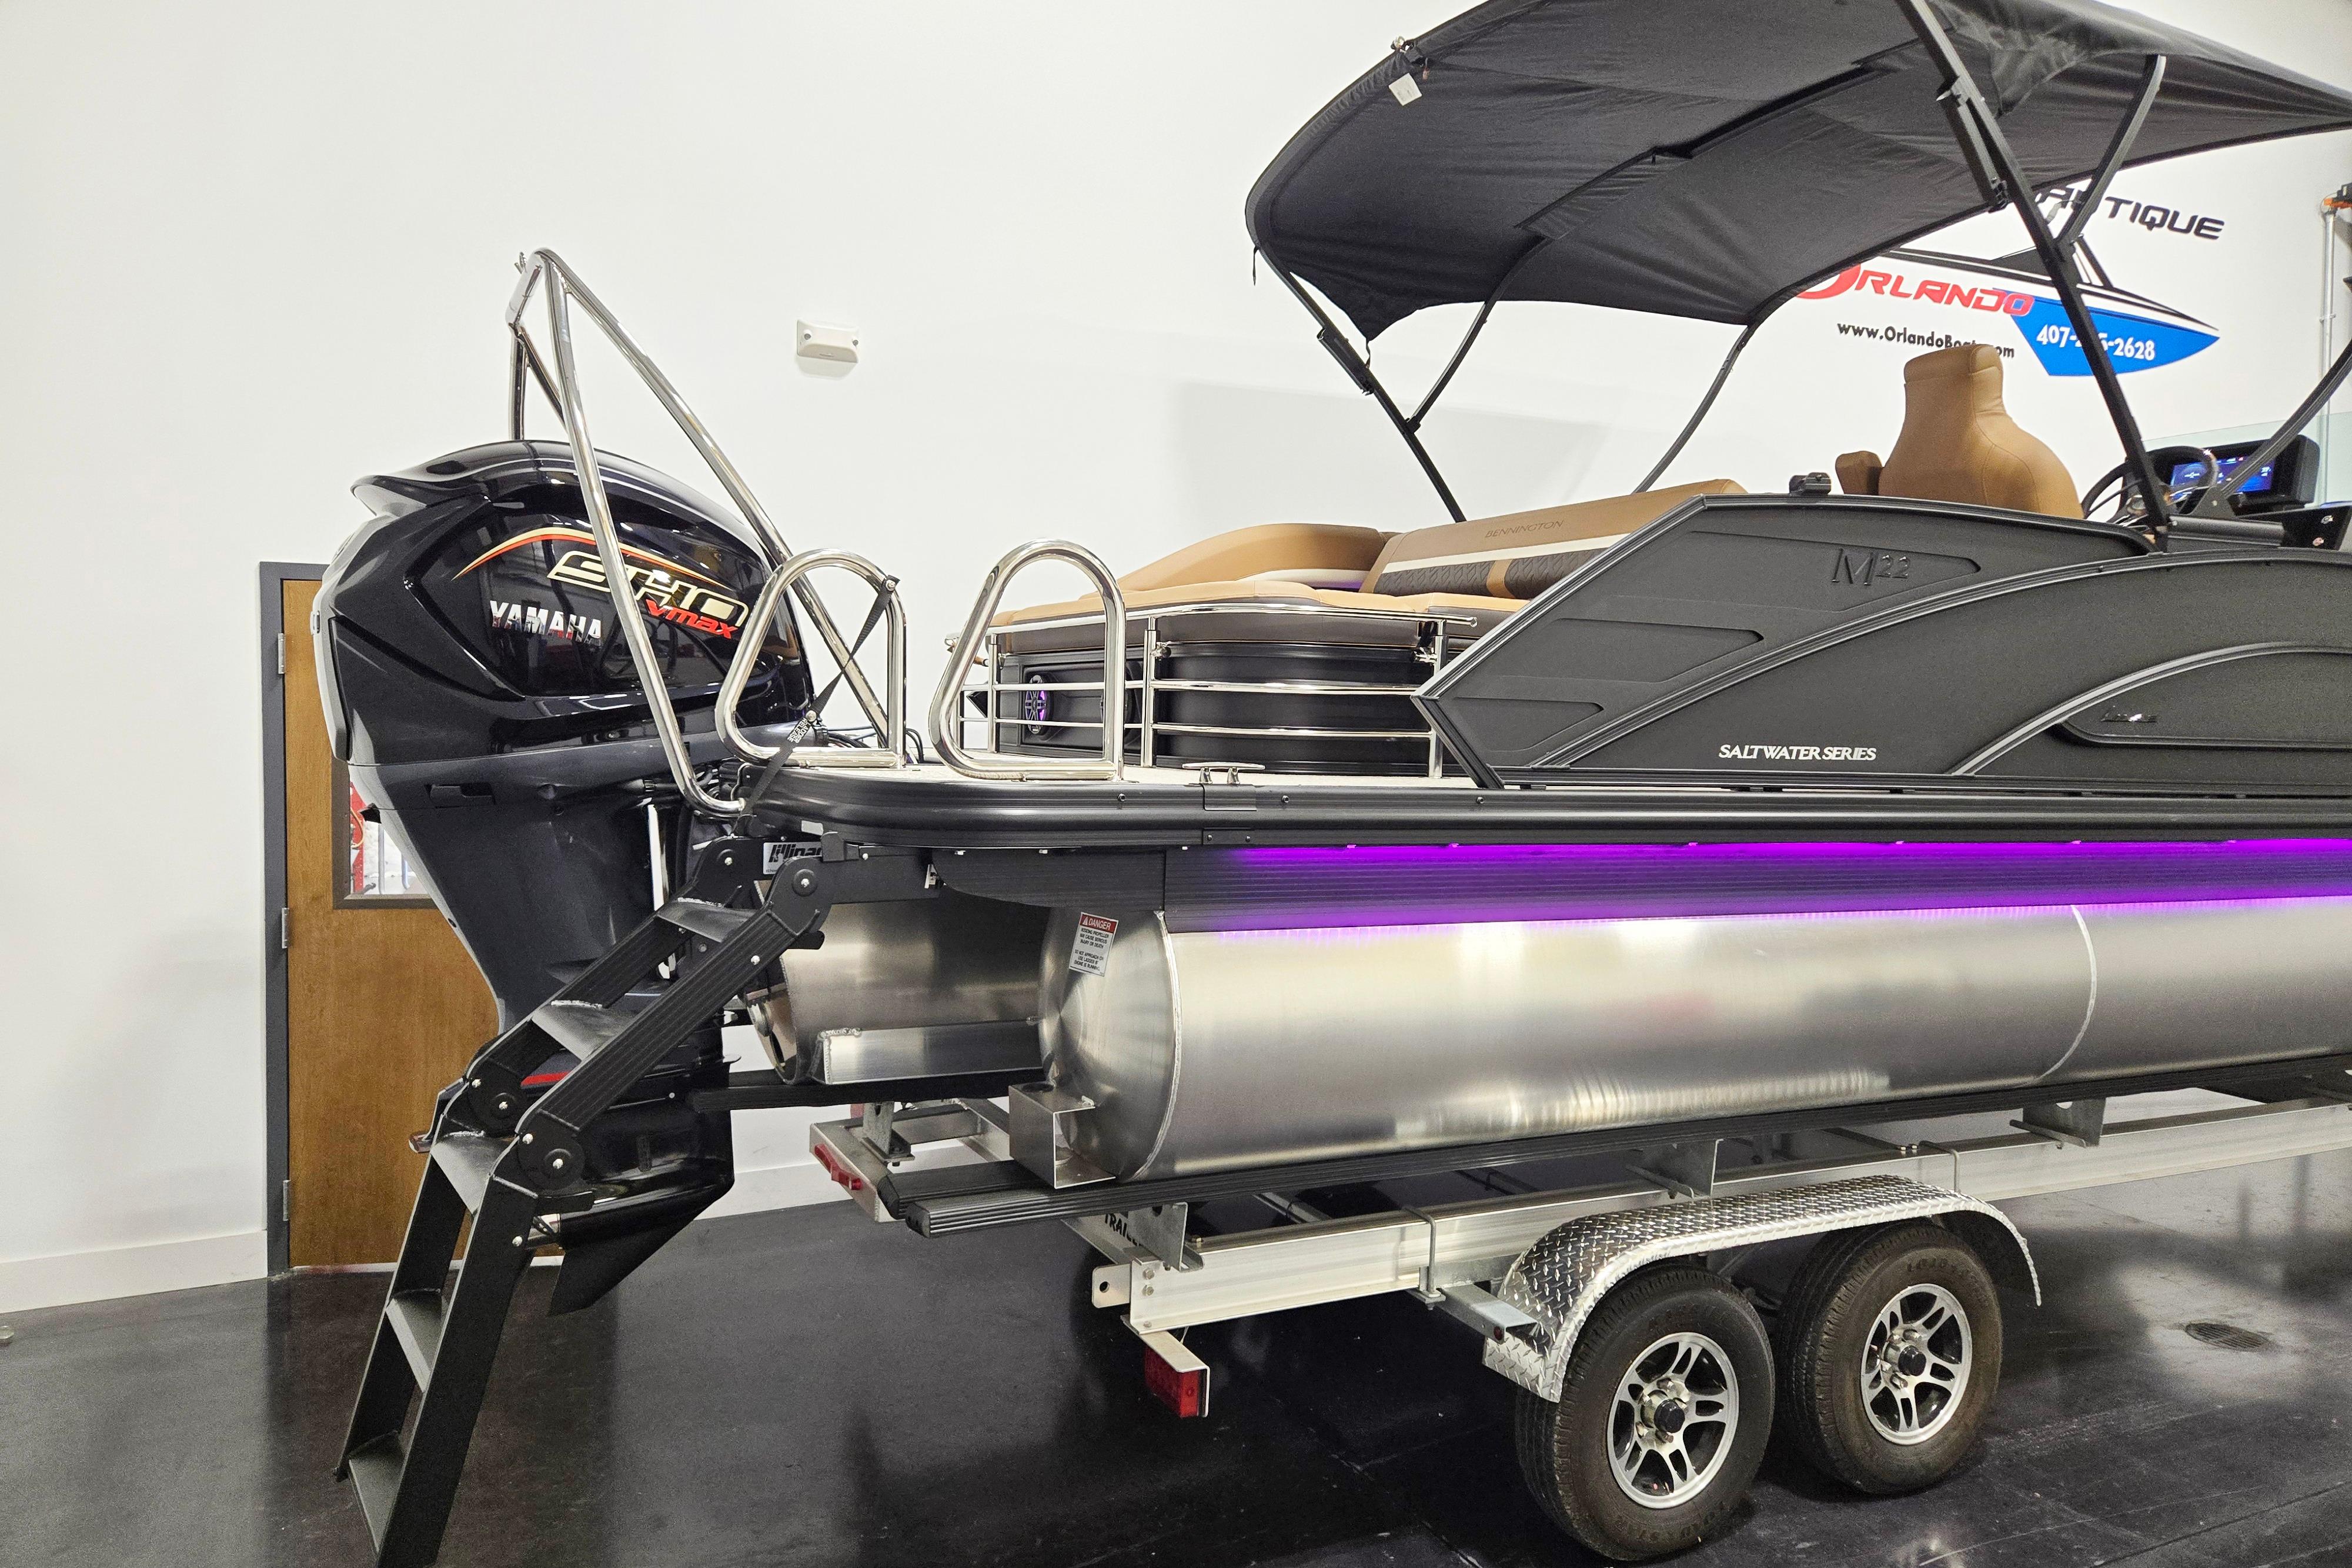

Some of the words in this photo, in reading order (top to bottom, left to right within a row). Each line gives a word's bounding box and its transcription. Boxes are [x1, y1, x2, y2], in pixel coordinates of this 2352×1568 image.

[2033, 187, 2225, 240] ATIQUE
[1837, 322, 2015, 359] www.OrlandoBoom
[2036, 324, 2156, 361] 407-5-2628
[1485, 520, 1564, 538] BENNINGTON
[490, 600, 602, 647] YAMAHA
[1718, 744, 1822, 760] SALTWATER
[1822, 746, 1877, 761] SERIES
[1088, 918, 1111, 930] DANGER
